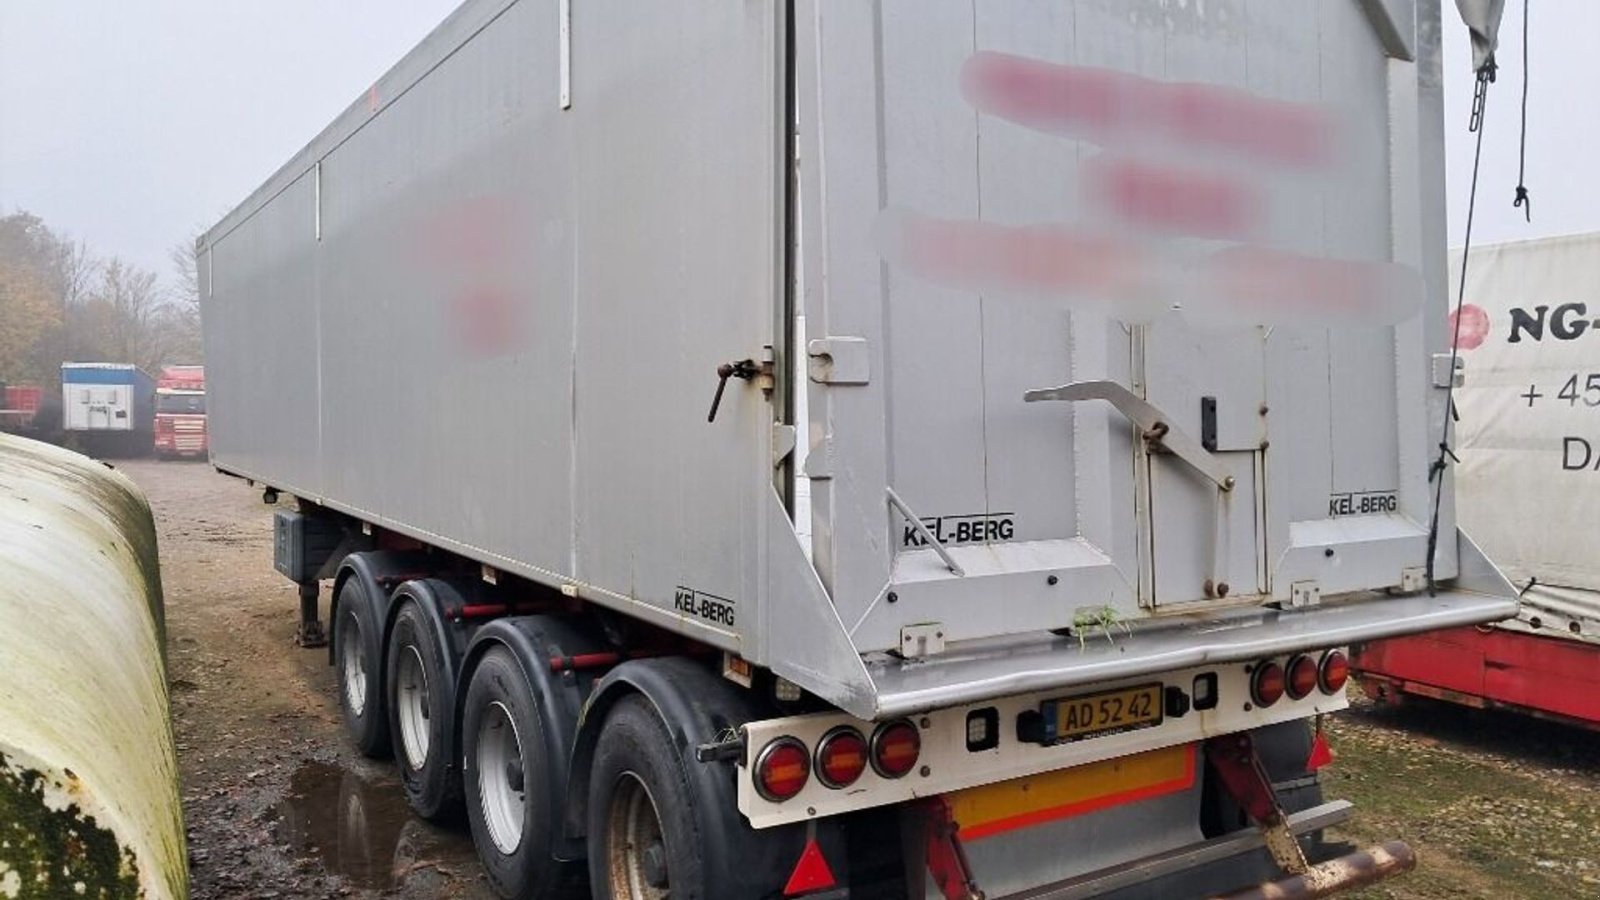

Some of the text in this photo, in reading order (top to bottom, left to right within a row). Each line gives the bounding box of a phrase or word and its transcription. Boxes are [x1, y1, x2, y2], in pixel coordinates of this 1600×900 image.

[1562, 436, 1600, 471] D
[1329, 493, 1397, 516] KEL-BERG
[675, 589, 735, 626] KEL-BERG
[1065, 693, 1152, 731] AD 52 42
